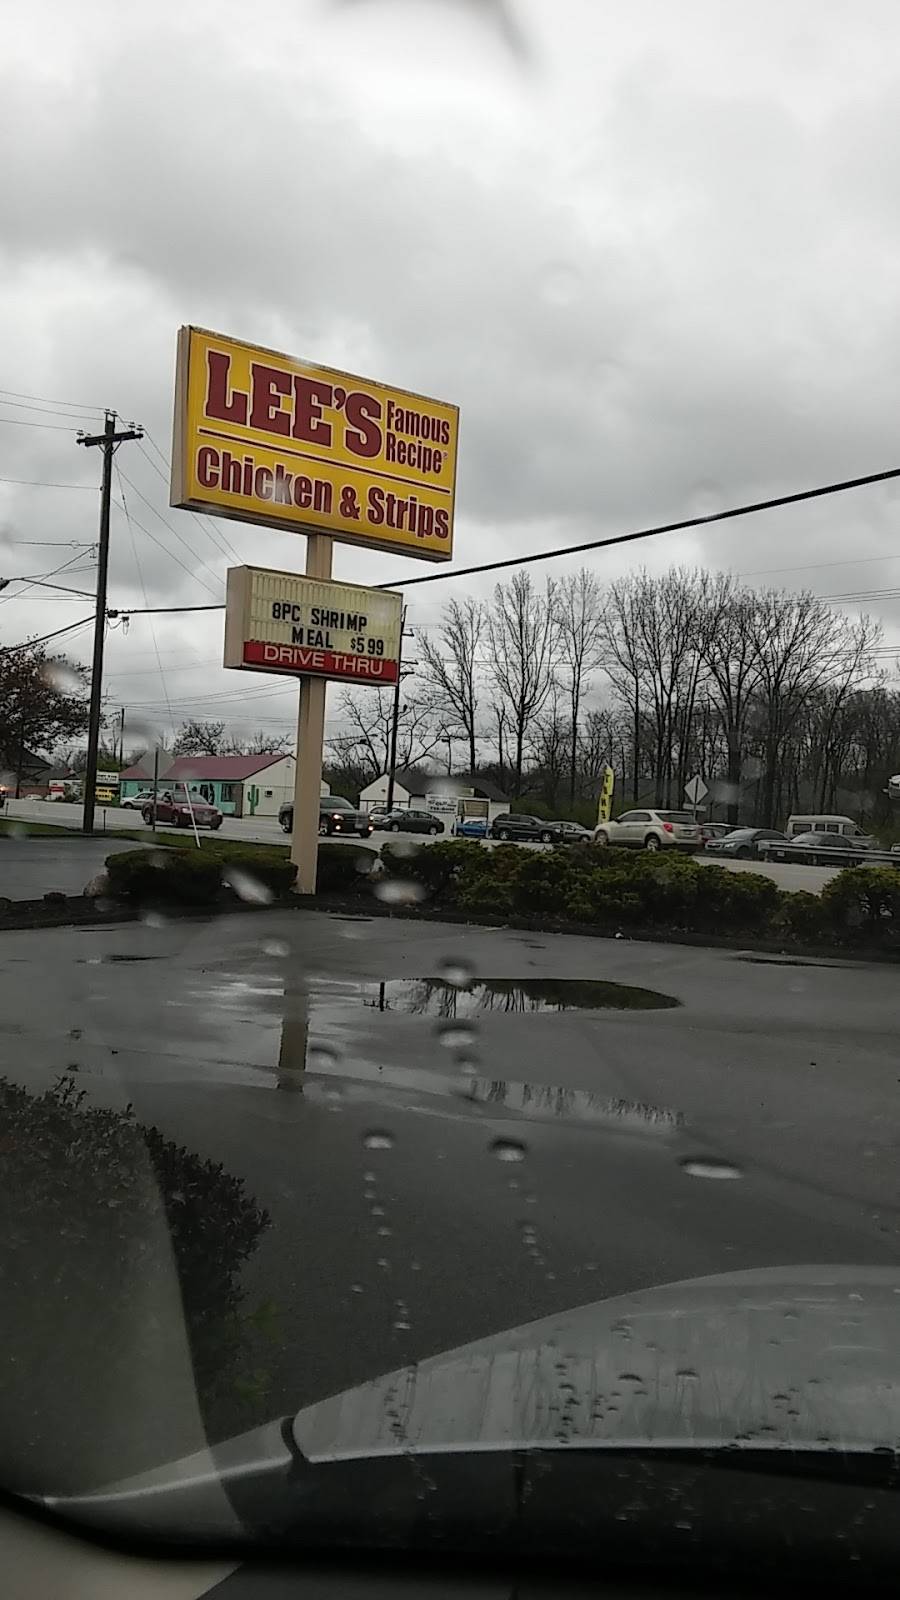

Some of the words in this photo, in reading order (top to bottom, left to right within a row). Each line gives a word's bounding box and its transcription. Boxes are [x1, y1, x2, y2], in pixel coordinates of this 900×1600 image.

[205, 349, 383, 458] LEE'S
[386, 400, 450, 445] Famous
[196, 446, 332, 513] Chicken
[339, 486, 361, 519] &
[368, 487, 449, 539] Strips
[272, 602, 301, 622] 8PC
[311, 608, 367, 632] SHRIMP
[292, 627, 333, 649] MEAL
[263, 645, 325, 667] DRIVE
[331, 654, 384, 675] THRU
